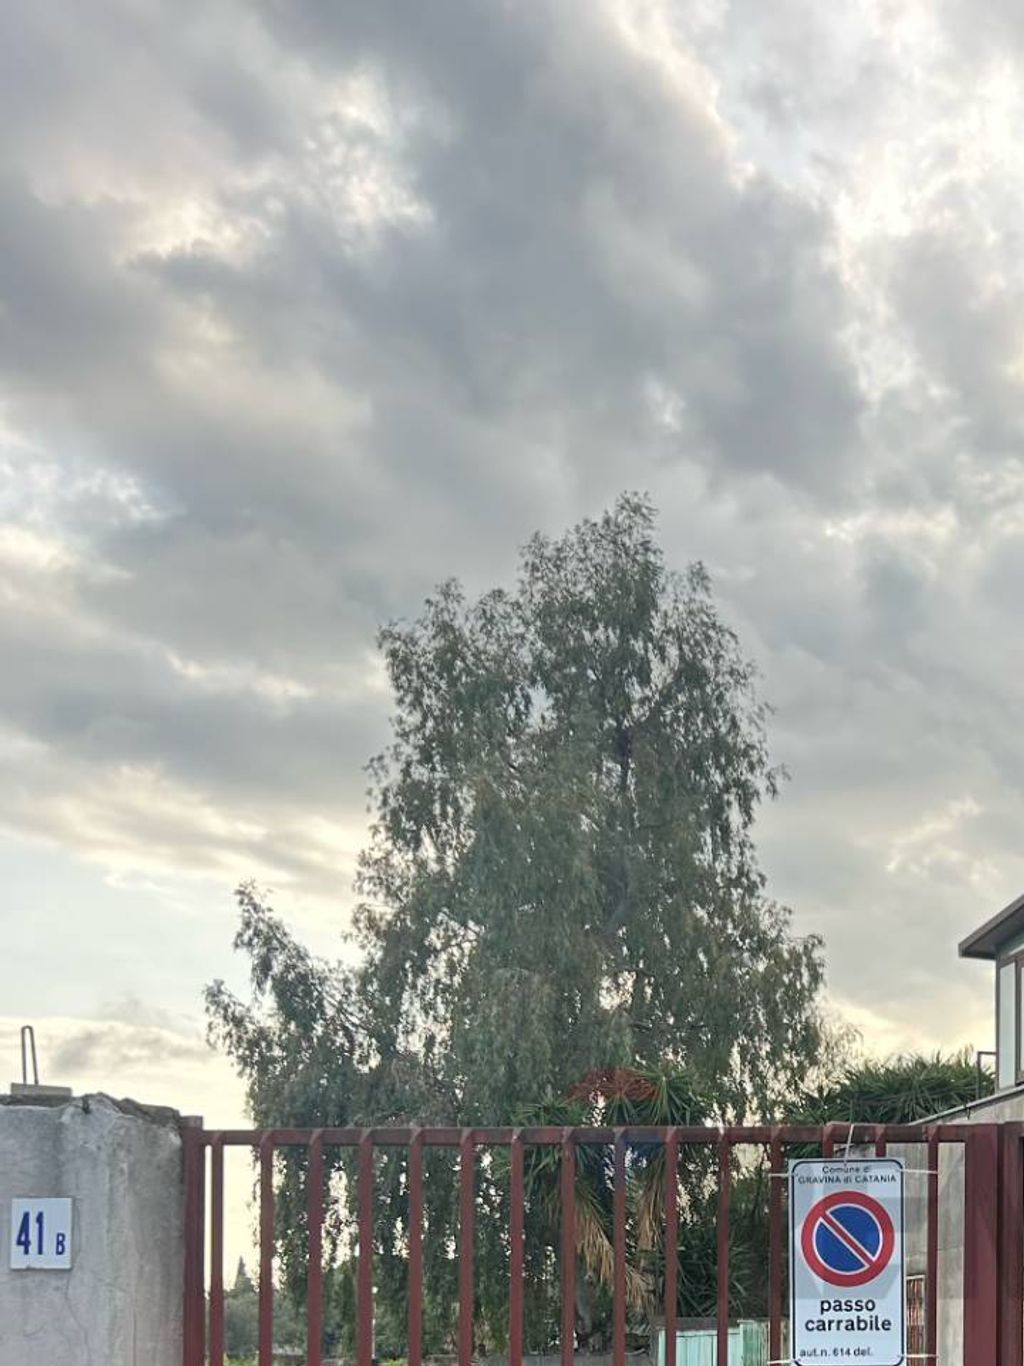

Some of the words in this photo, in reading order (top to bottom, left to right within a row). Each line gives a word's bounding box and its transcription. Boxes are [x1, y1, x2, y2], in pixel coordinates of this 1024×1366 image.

[822, 1165, 860, 1174] Comune
[798, 1175, 841, 1184] GRAVINA
[843, 1176, 852, 1184] di
[855, 1175, 897, 1184] CATANIA
[16, 1211, 44, 1255] 41
[55, 1232, 66, 1255] B
[820, 1299, 876, 1315] passo
[805, 1315, 892, 1331] carrabile
[833, 1347, 851, 1356] 614
